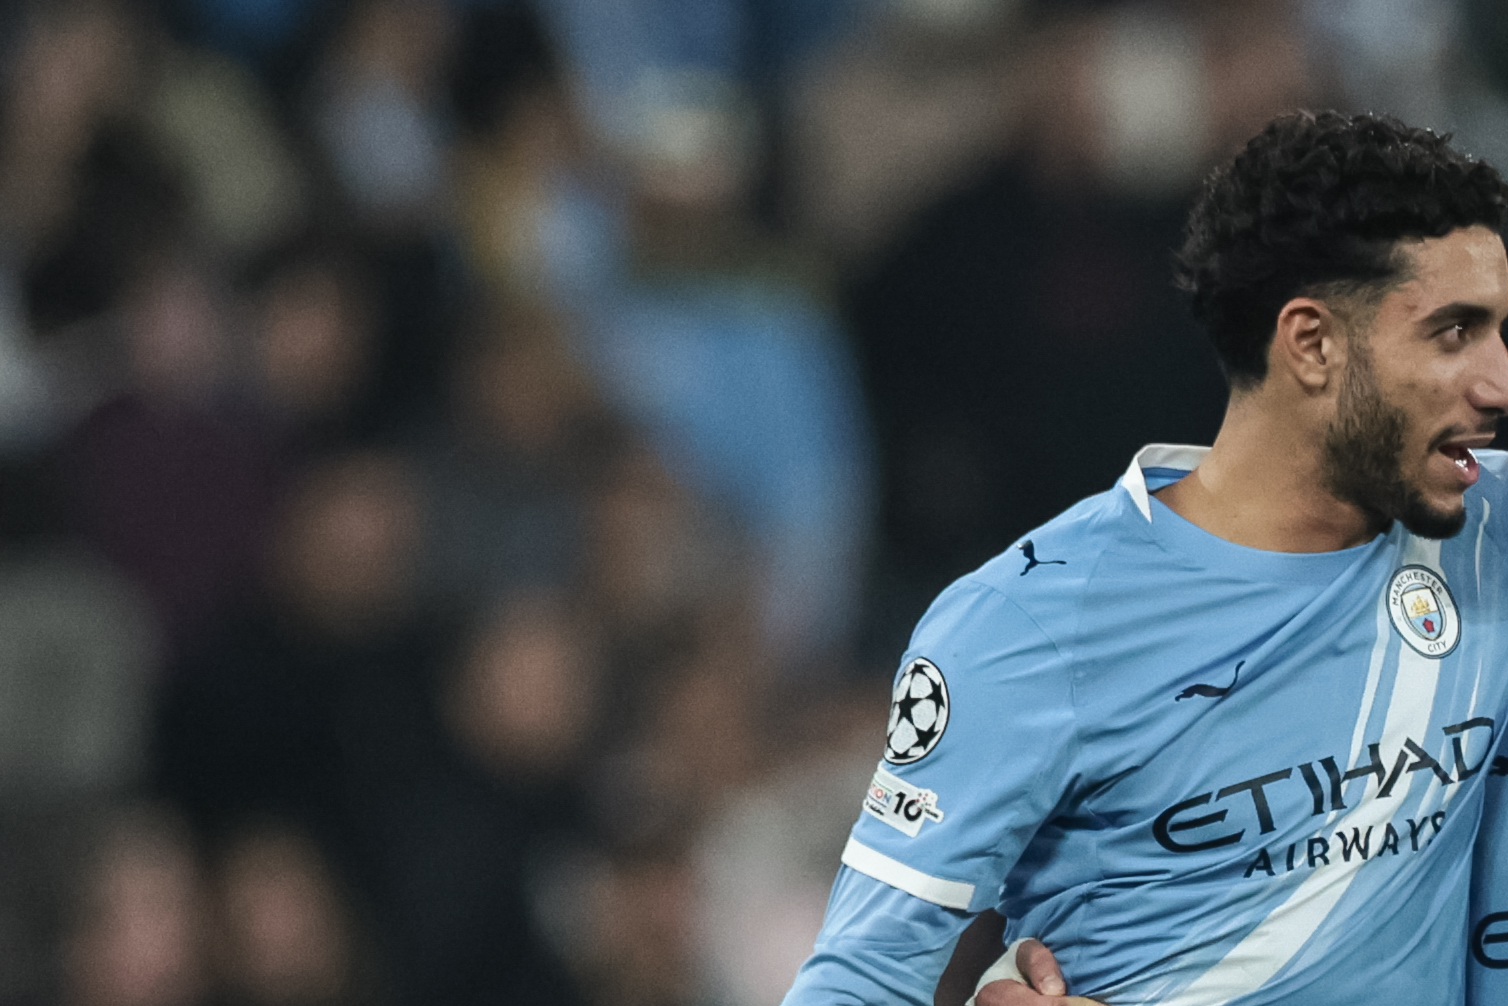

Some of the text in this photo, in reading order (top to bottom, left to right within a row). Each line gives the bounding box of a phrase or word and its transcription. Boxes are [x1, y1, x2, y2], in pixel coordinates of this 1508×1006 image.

[1392, 571, 1443, 606] MANCHESTER
[1427, 640, 1447, 653] CITY
[1152, 716, 1495, 853] ETIHAD
[894, 791, 923, 822] 10
[1243, 811, 1446, 878] AIRWAYS
